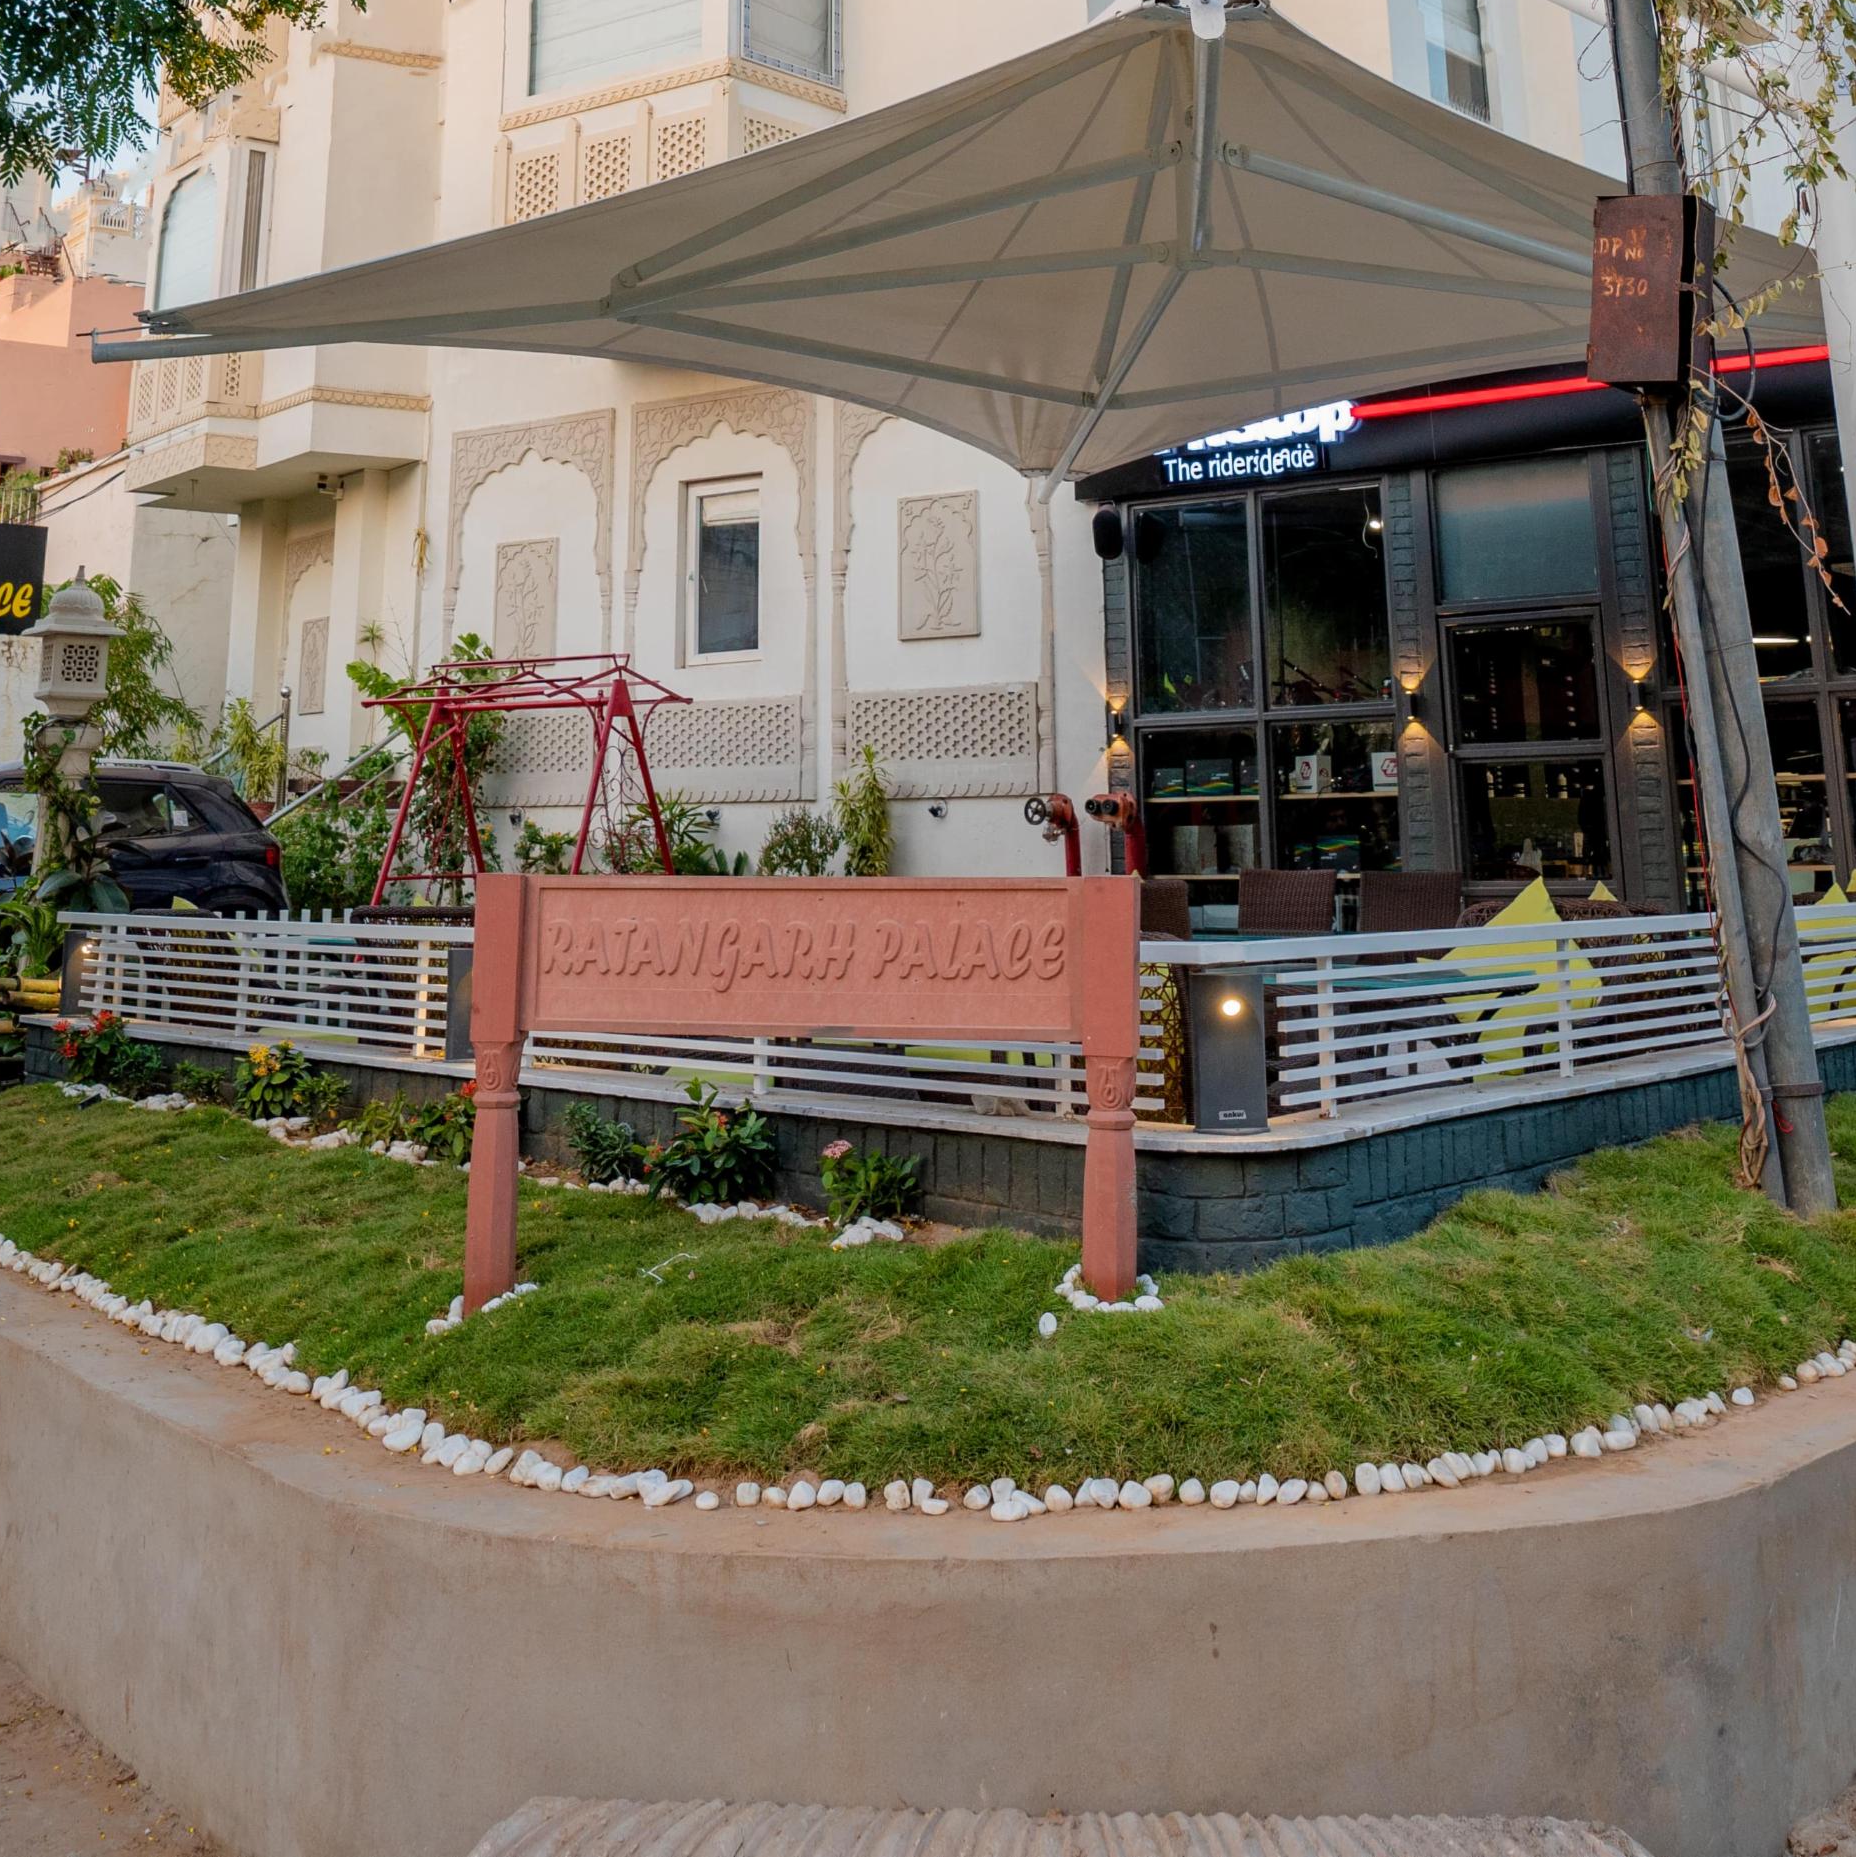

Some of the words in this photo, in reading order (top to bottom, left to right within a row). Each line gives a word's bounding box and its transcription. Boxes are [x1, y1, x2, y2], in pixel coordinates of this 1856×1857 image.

[1163, 457, 1203, 482] The
[543, 918, 856, 993] RATANGARH
[873, 919, 1066, 980] PALACE
